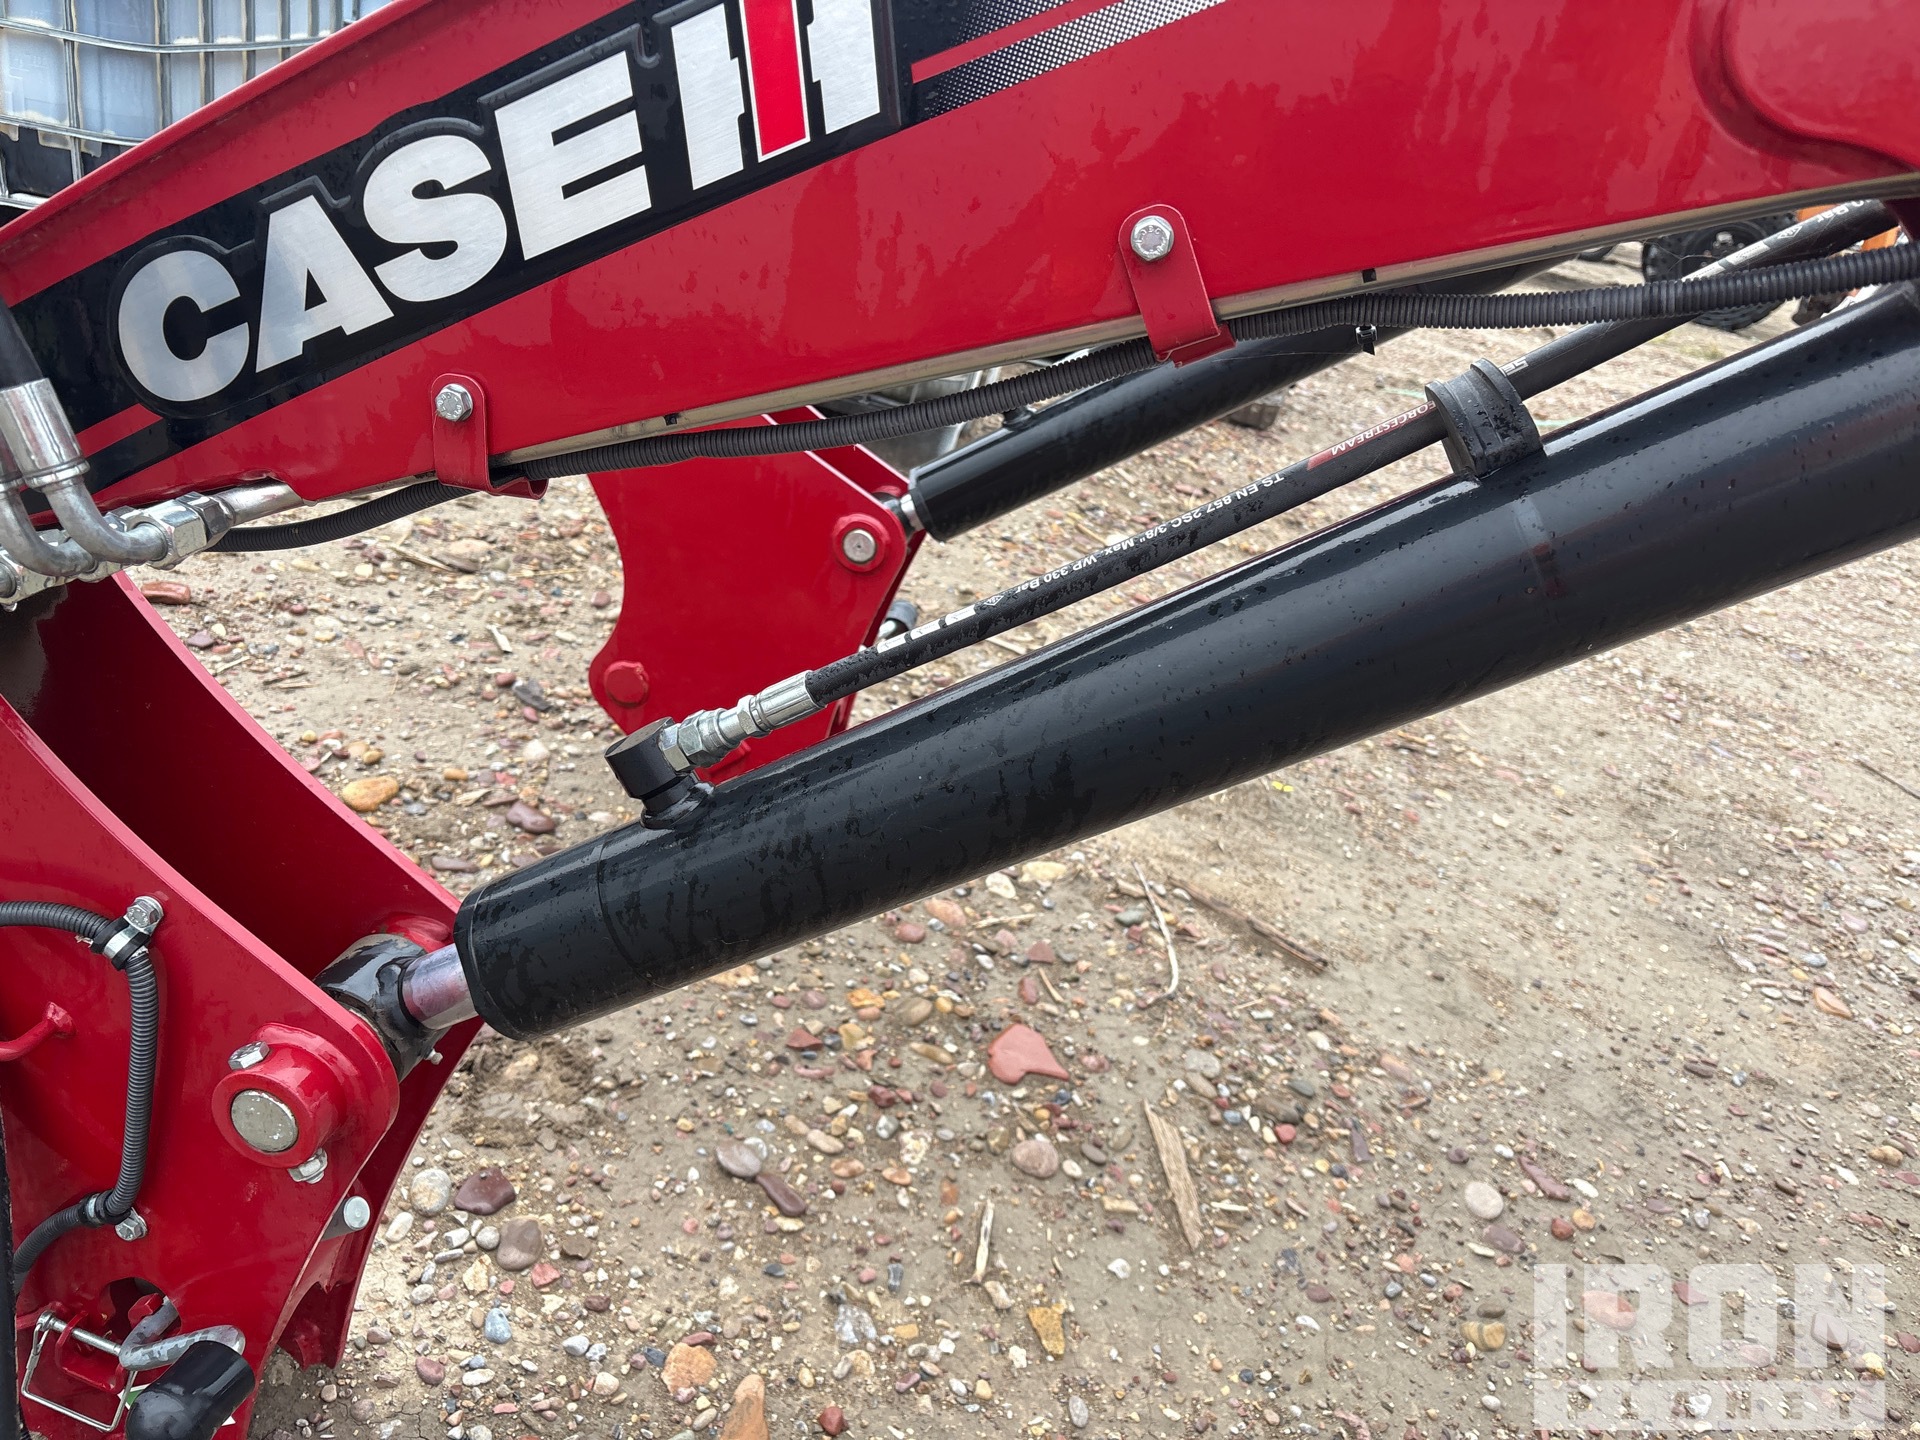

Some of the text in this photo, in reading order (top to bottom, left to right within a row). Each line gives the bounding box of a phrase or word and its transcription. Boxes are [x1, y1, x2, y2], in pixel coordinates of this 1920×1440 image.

[118, 51, 652, 402] CASE
[1331, 400, 1437, 456] FORCESTREAM
[1261, 473, 1285, 488] TS
[1236, 483, 1259, 500] EN
[1206, 495, 1232, 513] 857
[1170, 510, 1202, 528] 2SC
[1072, 555, 1098, 571] WP
[1043, 568, 1069, 583] 330
[1014, 580, 1040, 594] Bar
